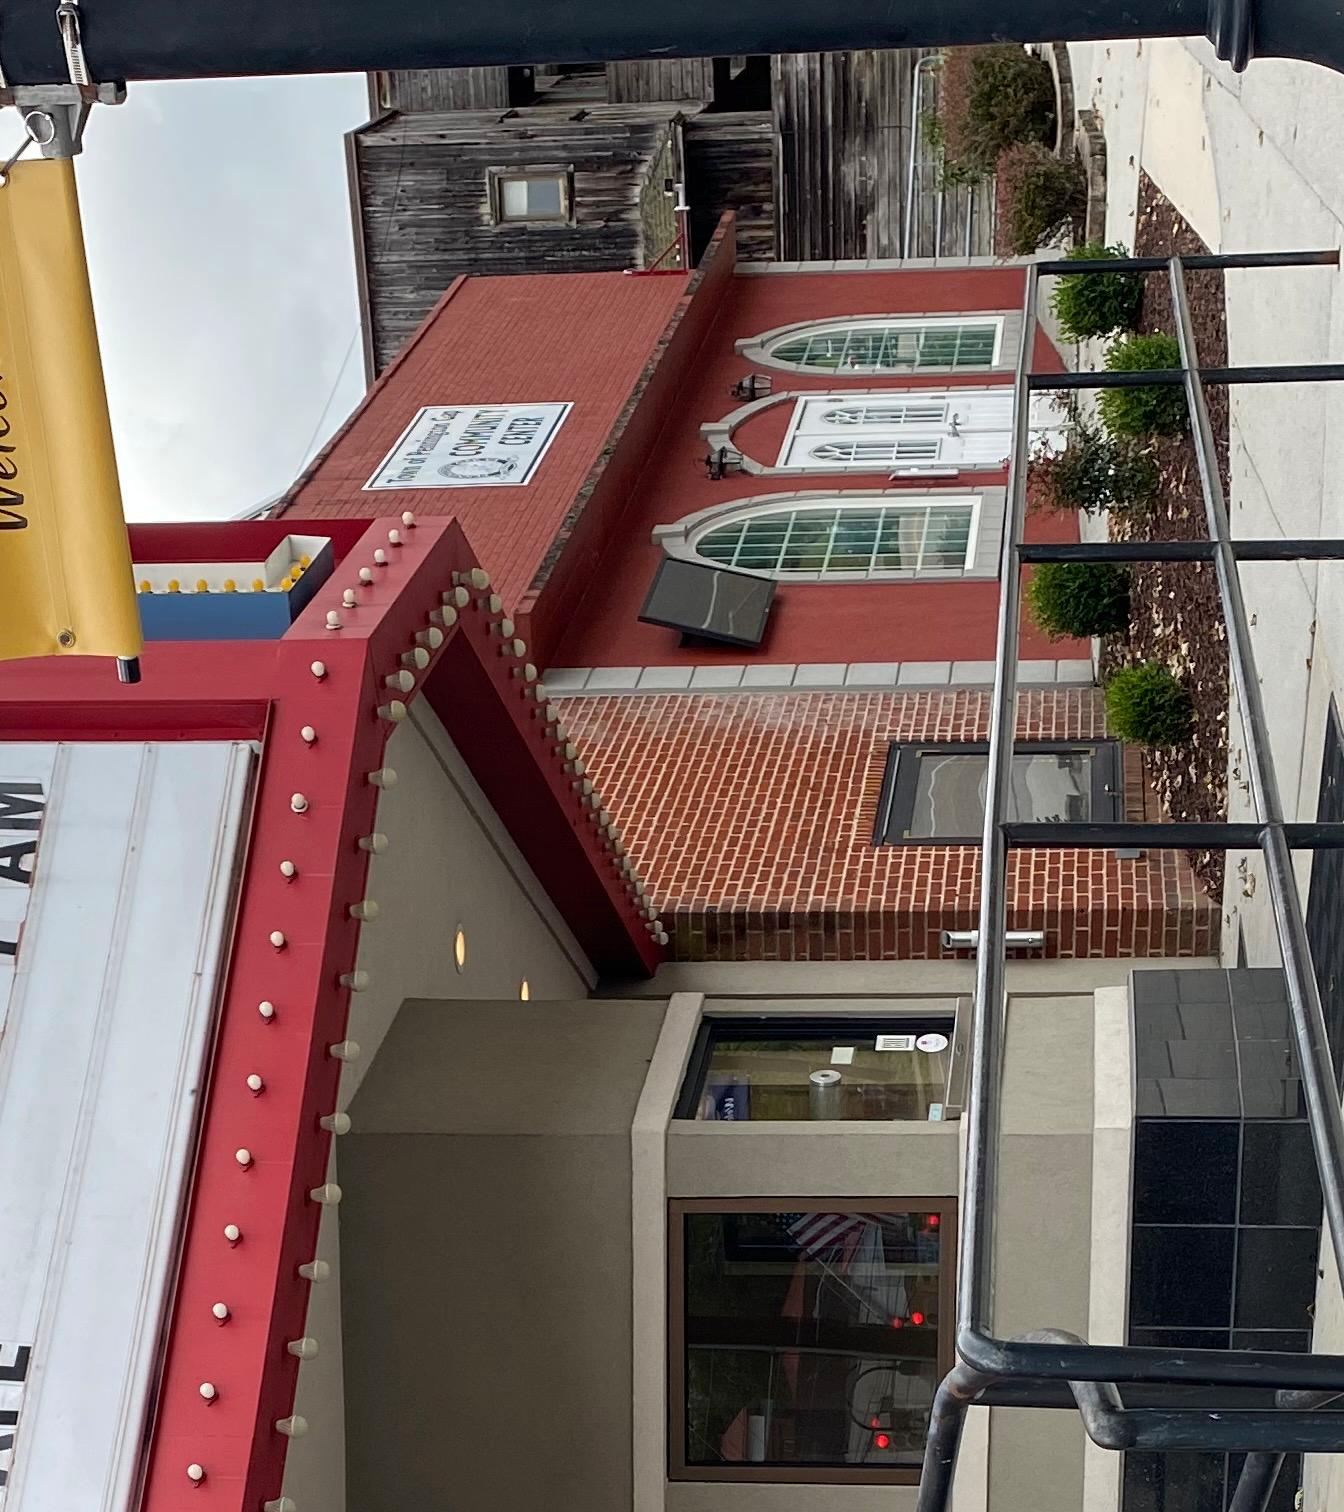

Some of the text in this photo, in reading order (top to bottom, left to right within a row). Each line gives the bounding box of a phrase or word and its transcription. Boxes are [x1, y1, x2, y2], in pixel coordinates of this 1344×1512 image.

[449, 409, 508, 457] COMMUNITY
[498, 416, 544, 445] CENTER
[387, 466, 421, 483] Town
